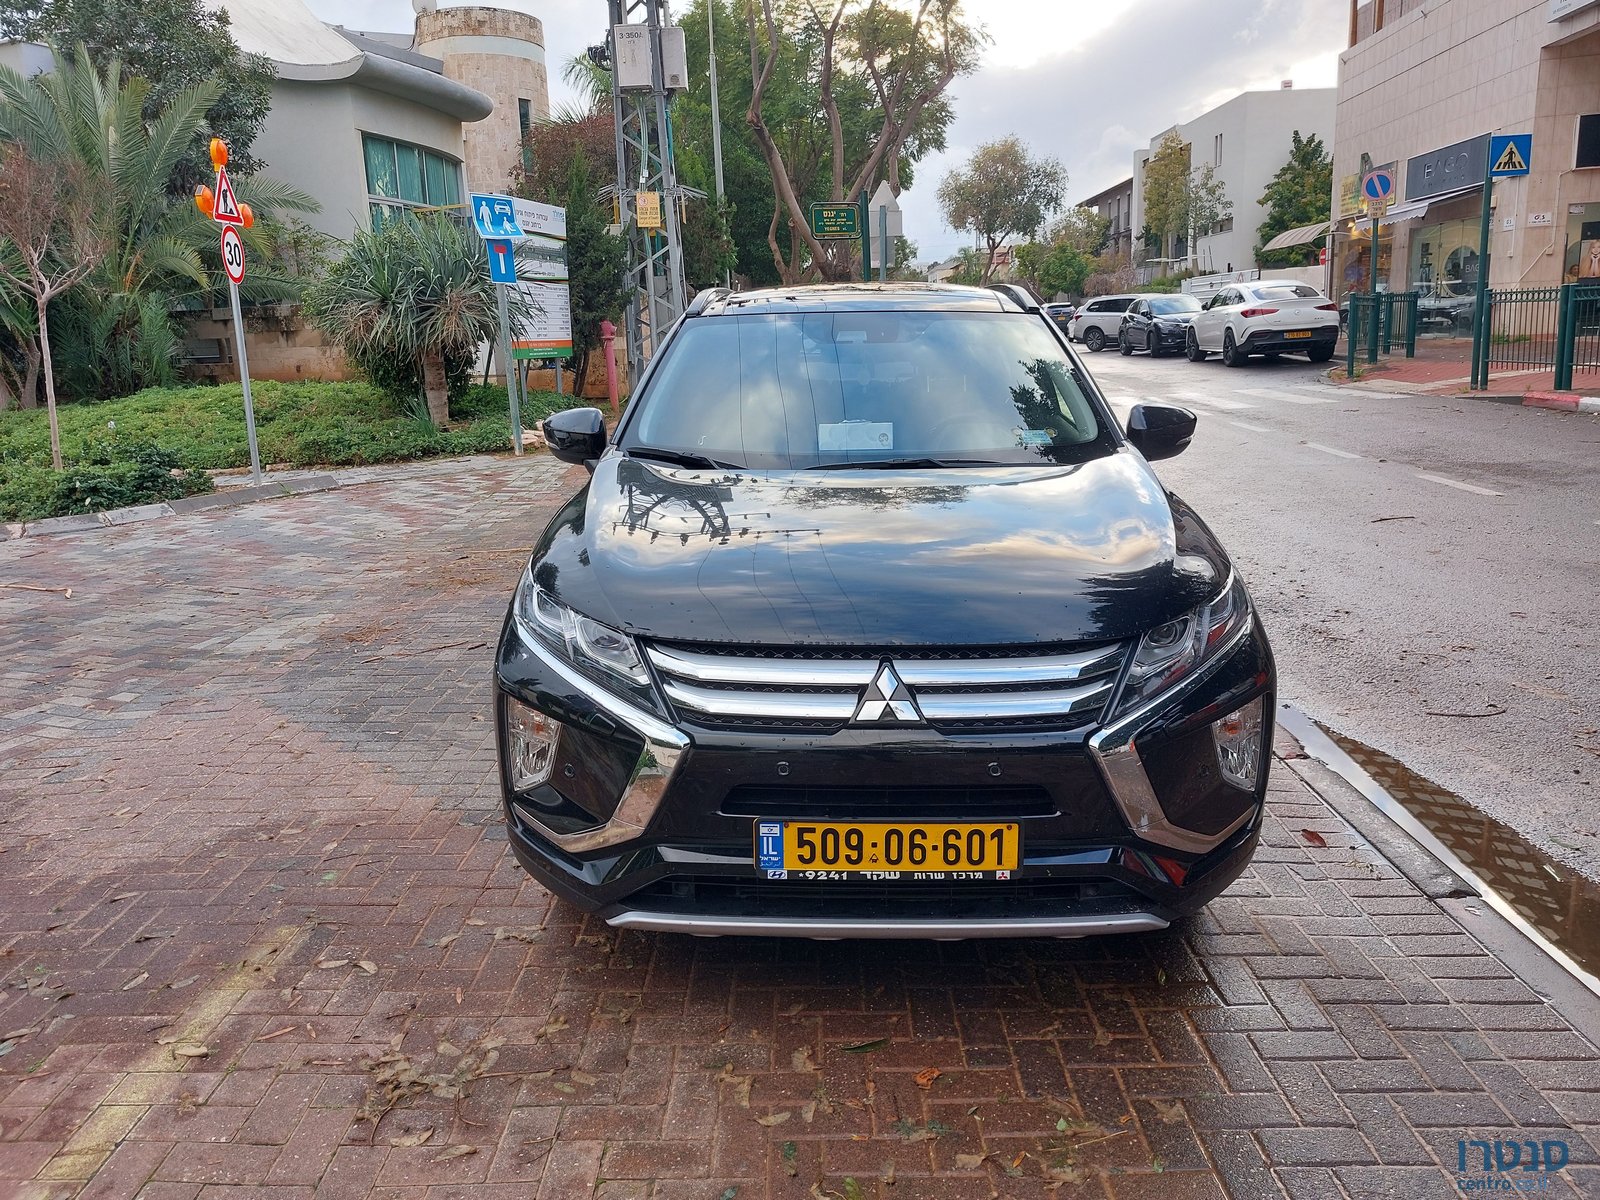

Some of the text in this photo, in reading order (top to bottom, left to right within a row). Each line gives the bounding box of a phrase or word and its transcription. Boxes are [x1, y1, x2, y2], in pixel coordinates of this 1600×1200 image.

[225, 241, 241, 268] 30
[1465, 263, 1480, 273] BAG
[763, 836, 778, 855] IL
[860, 871, 900, 880] שקד
[914, 872, 945, 880] שרות
[952, 872, 983, 880] מרכז
